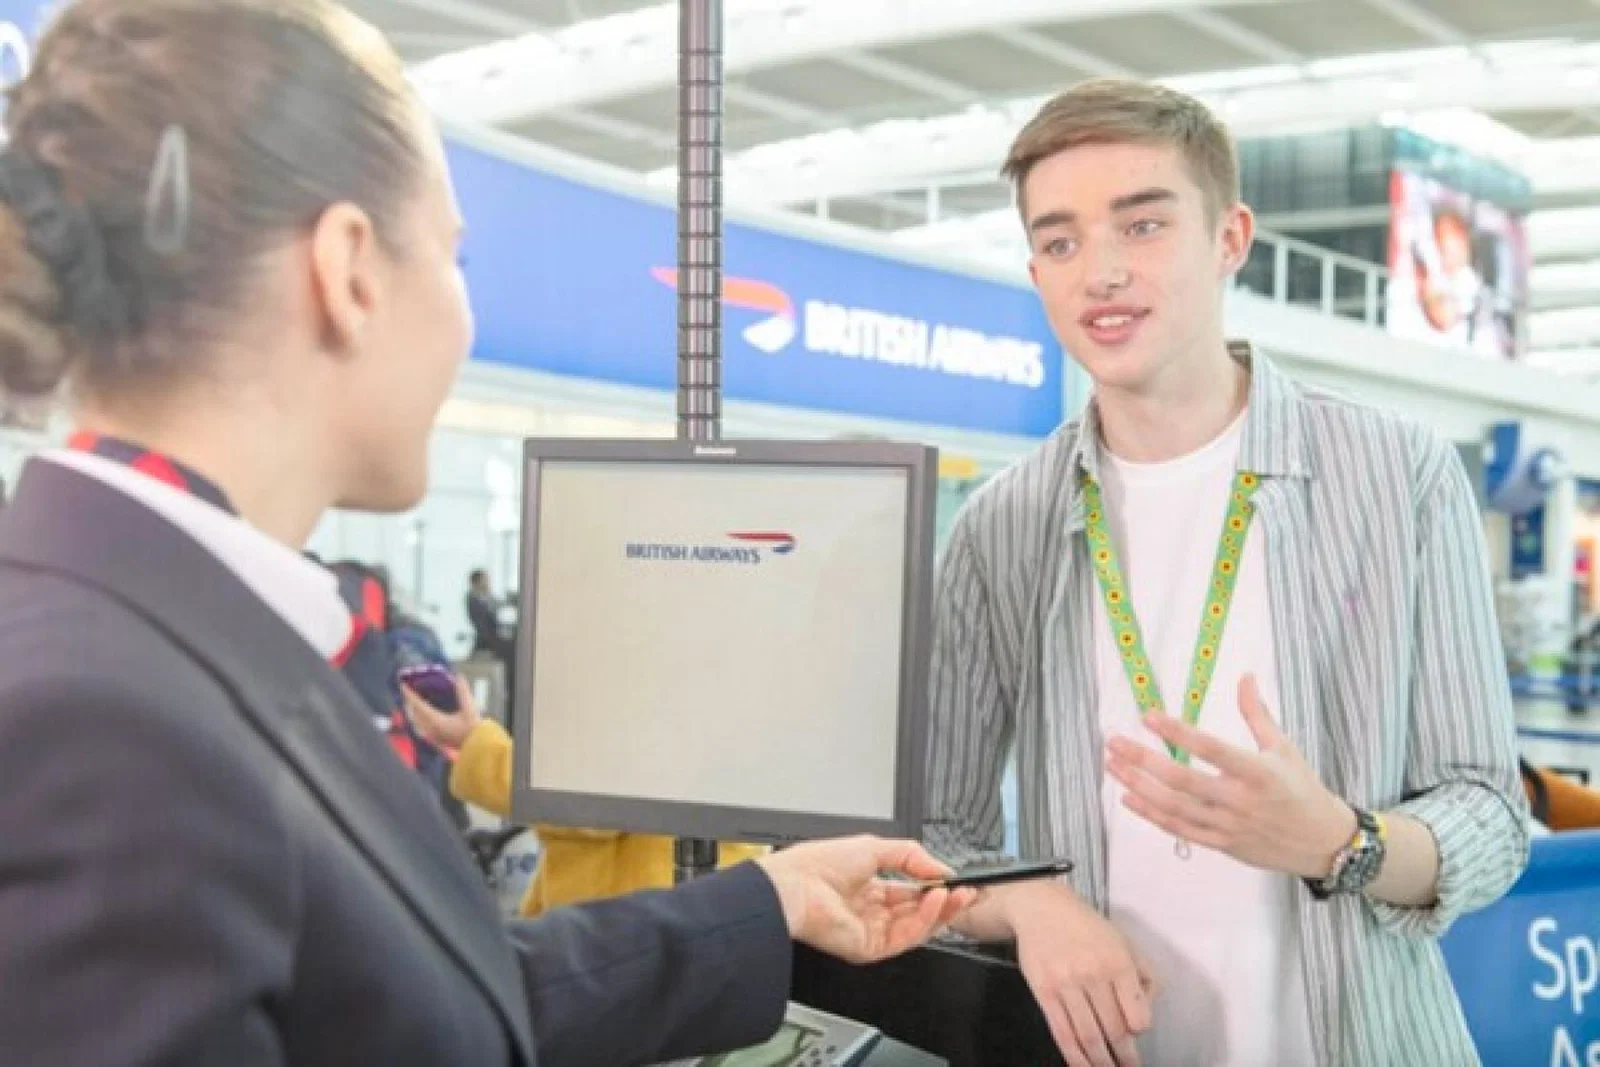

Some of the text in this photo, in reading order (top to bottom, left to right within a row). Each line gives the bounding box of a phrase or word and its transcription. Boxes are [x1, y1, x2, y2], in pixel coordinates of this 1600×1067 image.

[804, 299, 929, 370] BRITISH
[626, 543, 761, 565] BRITISH AIRWAYS
[1528, 917, 1600, 1014] Sp
